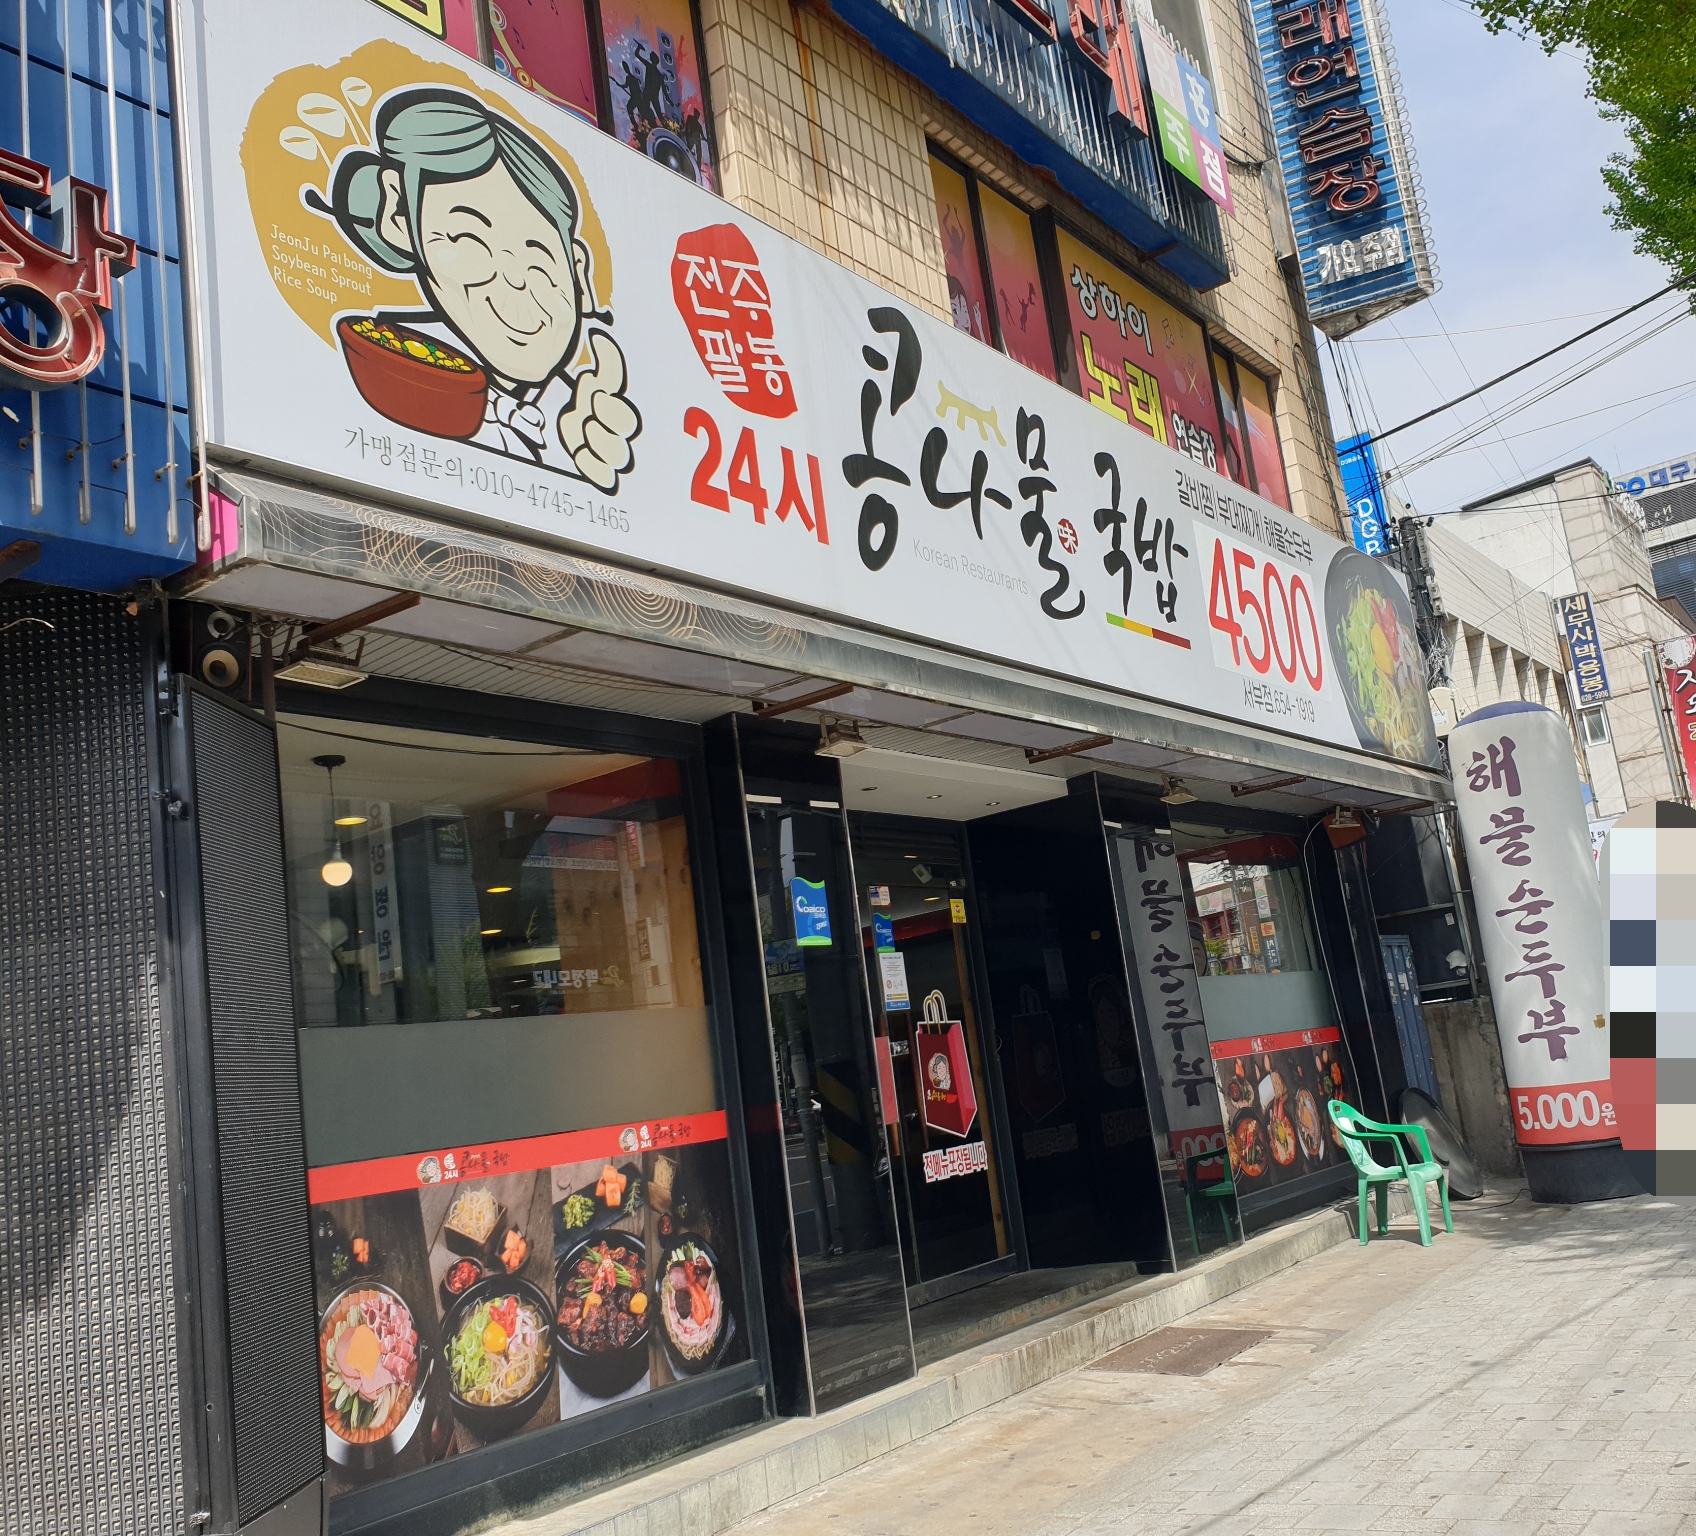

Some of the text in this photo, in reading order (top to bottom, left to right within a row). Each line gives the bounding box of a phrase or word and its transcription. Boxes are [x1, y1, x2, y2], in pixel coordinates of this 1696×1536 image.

[1270, 0, 1386, 211] 래연습장
[270, 223, 318, 256] JeonJu
[271, 245, 373, 297] Soybean Sprout
[273, 265, 338, 305] Rice Soup
[676, 253, 771, 323] 전주
[1070, 263, 1154, 357] 상하이
[1080, 331, 1169, 445] 노래
[1171, 410, 1218, 473] 연습장
[1648, 459, 1696, 487] 대구
[682, 406, 830, 546] 24시
[912, 537, 1029, 596] Korean Restaurants
[1057, 520, 1079, 554] 味
[1208, 537, 1323, 692] 4500
[1466, 735, 1581, 1063] 해물순두부
[924, 1143, 987, 1180] 전메뉴포장됩니다
